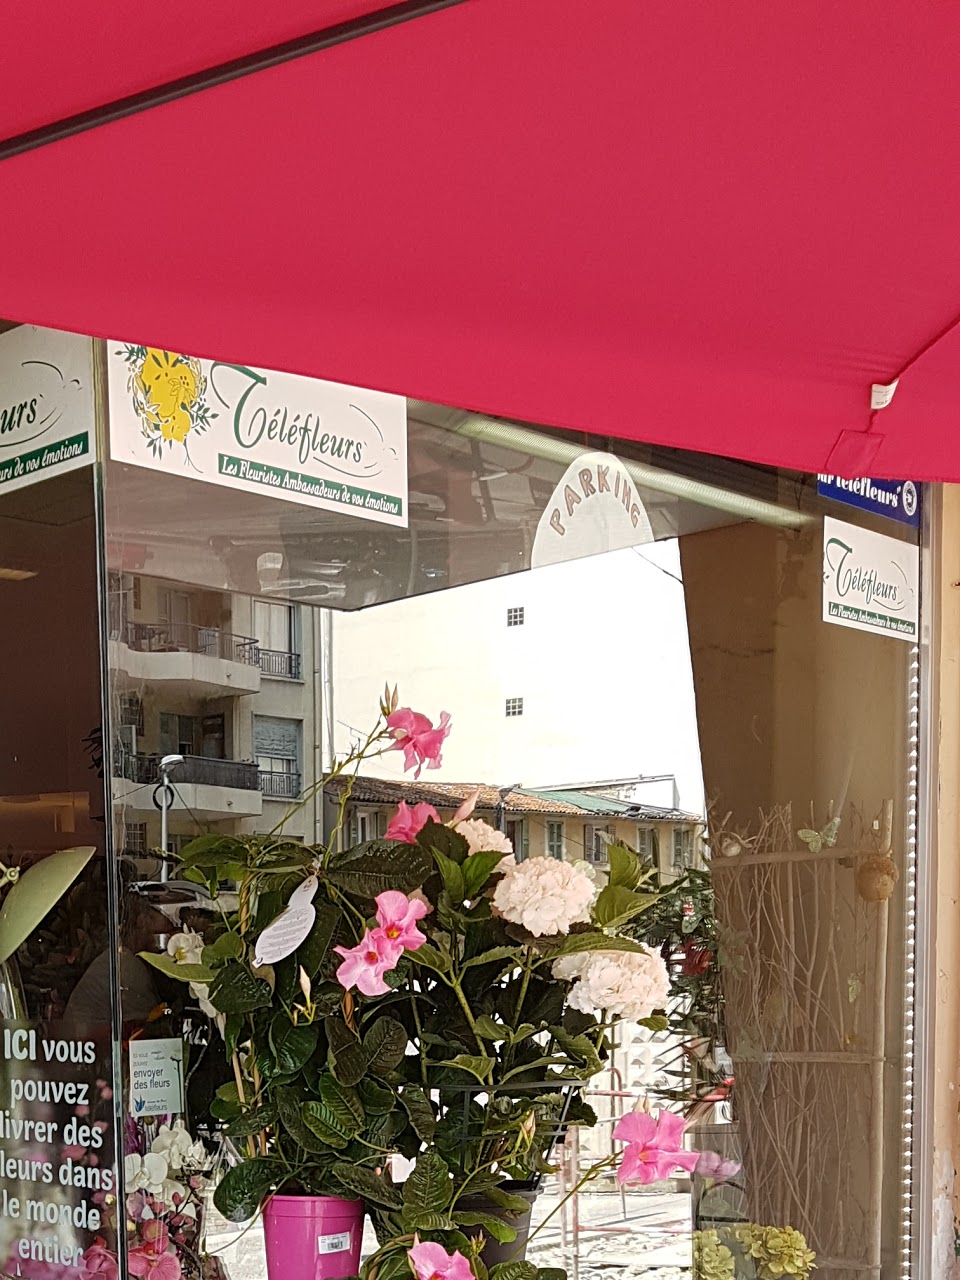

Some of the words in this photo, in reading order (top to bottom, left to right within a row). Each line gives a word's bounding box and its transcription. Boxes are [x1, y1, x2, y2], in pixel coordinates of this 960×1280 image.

[210, 361, 363, 464] Téléfleurs
[14, 458, 24, 476] de
[25, 456, 41, 473] vos
[41, 441, 83, 466] émotions
[222, 456, 238, 475] Les
[239, 460, 282, 486] Fleuristes
[282, 472, 340, 501] Ambassadeurs
[341, 484, 350, 502] de
[351, 491, 364, 505] vos
[364, 492, 398, 514] émotions
[549, 464, 641, 536] PARKING
[825, 537, 898, 605] Téléfleurs
[4, 1028, 37, 1060] ICI
[42, 1039, 96, 1064] vous
[133, 1068, 164, 1081] envoyer
[133, 1080, 148, 1090] des
[149, 1079, 171, 1088] fleurs
[10, 1079, 90, 1109] pouvez
[63, 1116, 103, 1148] des
[58, 1157, 113, 1191] dans
[2, 1189, 20, 1218] le
[25, 1199, 100, 1231] monde
[18, 1235, 84, 1267] entier
